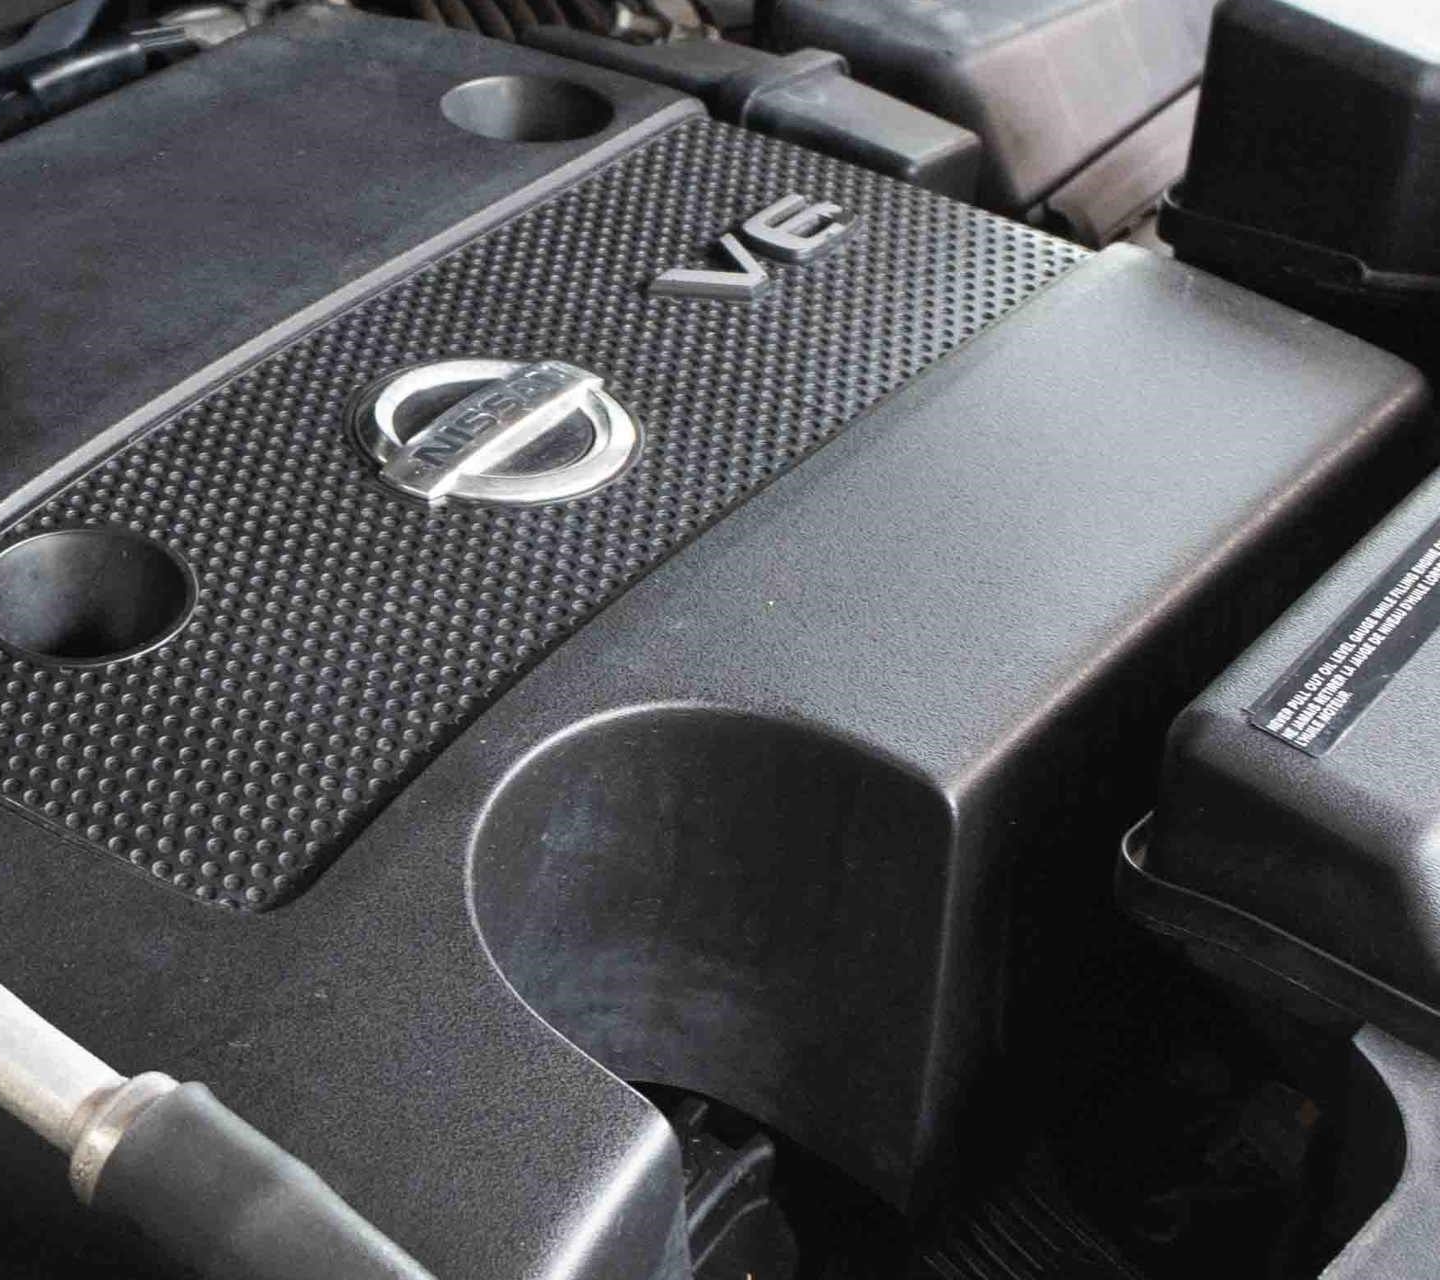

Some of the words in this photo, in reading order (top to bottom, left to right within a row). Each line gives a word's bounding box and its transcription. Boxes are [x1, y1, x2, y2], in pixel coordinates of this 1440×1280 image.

[648, 194, 855, 301] V6
[412, 362, 570, 470] NISSAN
[1287, 691, 1312, 710] PULL
[1304, 673, 1325, 691] OUT
[1318, 662, 1338, 675] OIL
[1329, 642, 1357, 663] LEVEL
[1369, 596, 1397, 619] WHILE
[1389, 572, 1419, 599] FILLING
[1312, 674, 1348, 705] RETIRER
[1339, 665, 1356, 677] LA
[1348, 642, 1376, 667] JAUGE
[1367, 632, 1386, 645] DE
[1399, 583, 1431, 611] D'HUILE
